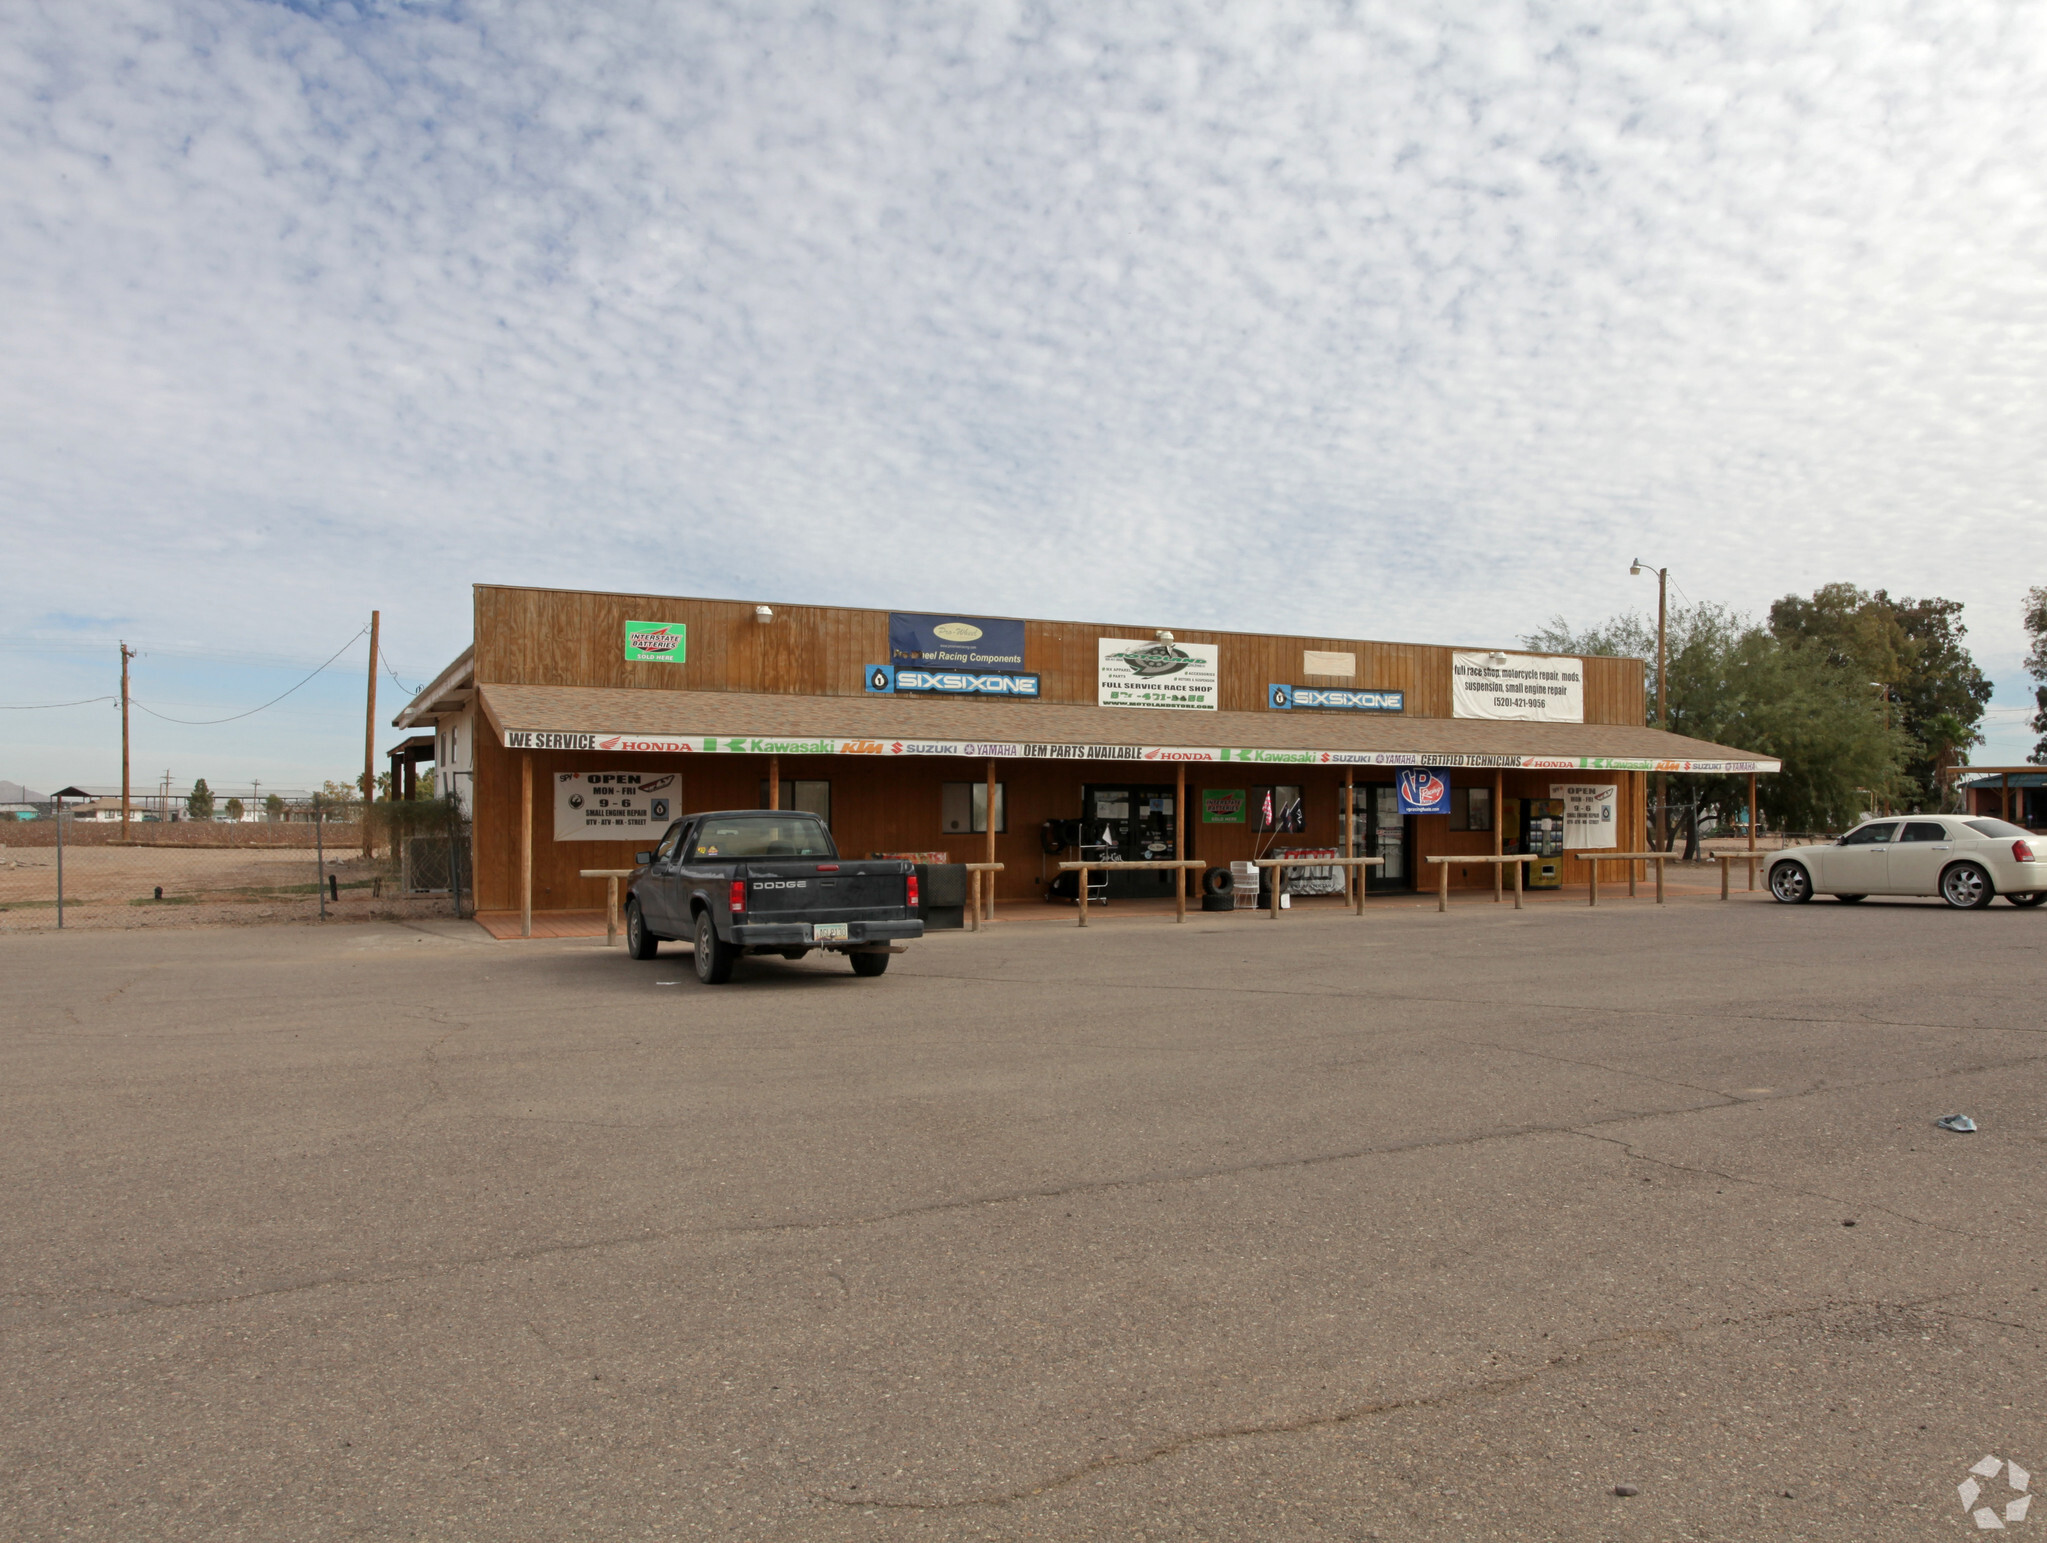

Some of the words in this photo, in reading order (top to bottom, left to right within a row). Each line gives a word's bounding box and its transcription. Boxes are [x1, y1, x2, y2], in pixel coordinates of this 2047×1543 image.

[939, 652, 967, 663] Racing
[970, 653, 1021, 664] Components
[1467, 667, 1482, 676] race
[1502, 669, 1538, 680] motorcycle
[898, 674, 1035, 692] SIXSIXONE
[1525, 684, 1546, 695] engine
[1548, 686, 1567, 696] repair
[1103, 701, 1214, 709] WWW.MOTOLANDSTORE.COM
[1294, 692, 1400, 707] SIXSIXONE
[509, 732, 532, 746] WE
[536, 733, 595, 749] SERVICE
[622, 742, 693, 751] HONDA
[751, 739, 834, 753] Kawasaki
[840, 740, 884, 754] KTM
[906, 744, 957, 754] SUZUKI
[977, 744, 1017, 756] YAMAHA
[1024, 744, 1047, 757] OEM
[1050, 745, 1084, 758] PARTS
[1087, 746, 1142, 759] AVAILABLE
[1255, 752, 1316, 763] Kawasaki
[1386, 754, 1415, 764] YAMAHA
[1421, 755, 1463, 766] CERTIFIED
[1466, 755, 1521, 766] TECHNICIANS
[1606, 759, 1653, 770] Kawasaki
[1732, 762, 1755, 771] YAMAHA
[560, 774, 572, 782] SPY
[587, 775, 641, 784] OPEN
[1402, 768, 1432, 804] VP
[600, 799, 608, 807] 9
[622, 799, 631, 807] 6
[753, 881, 806, 890] DODGE
